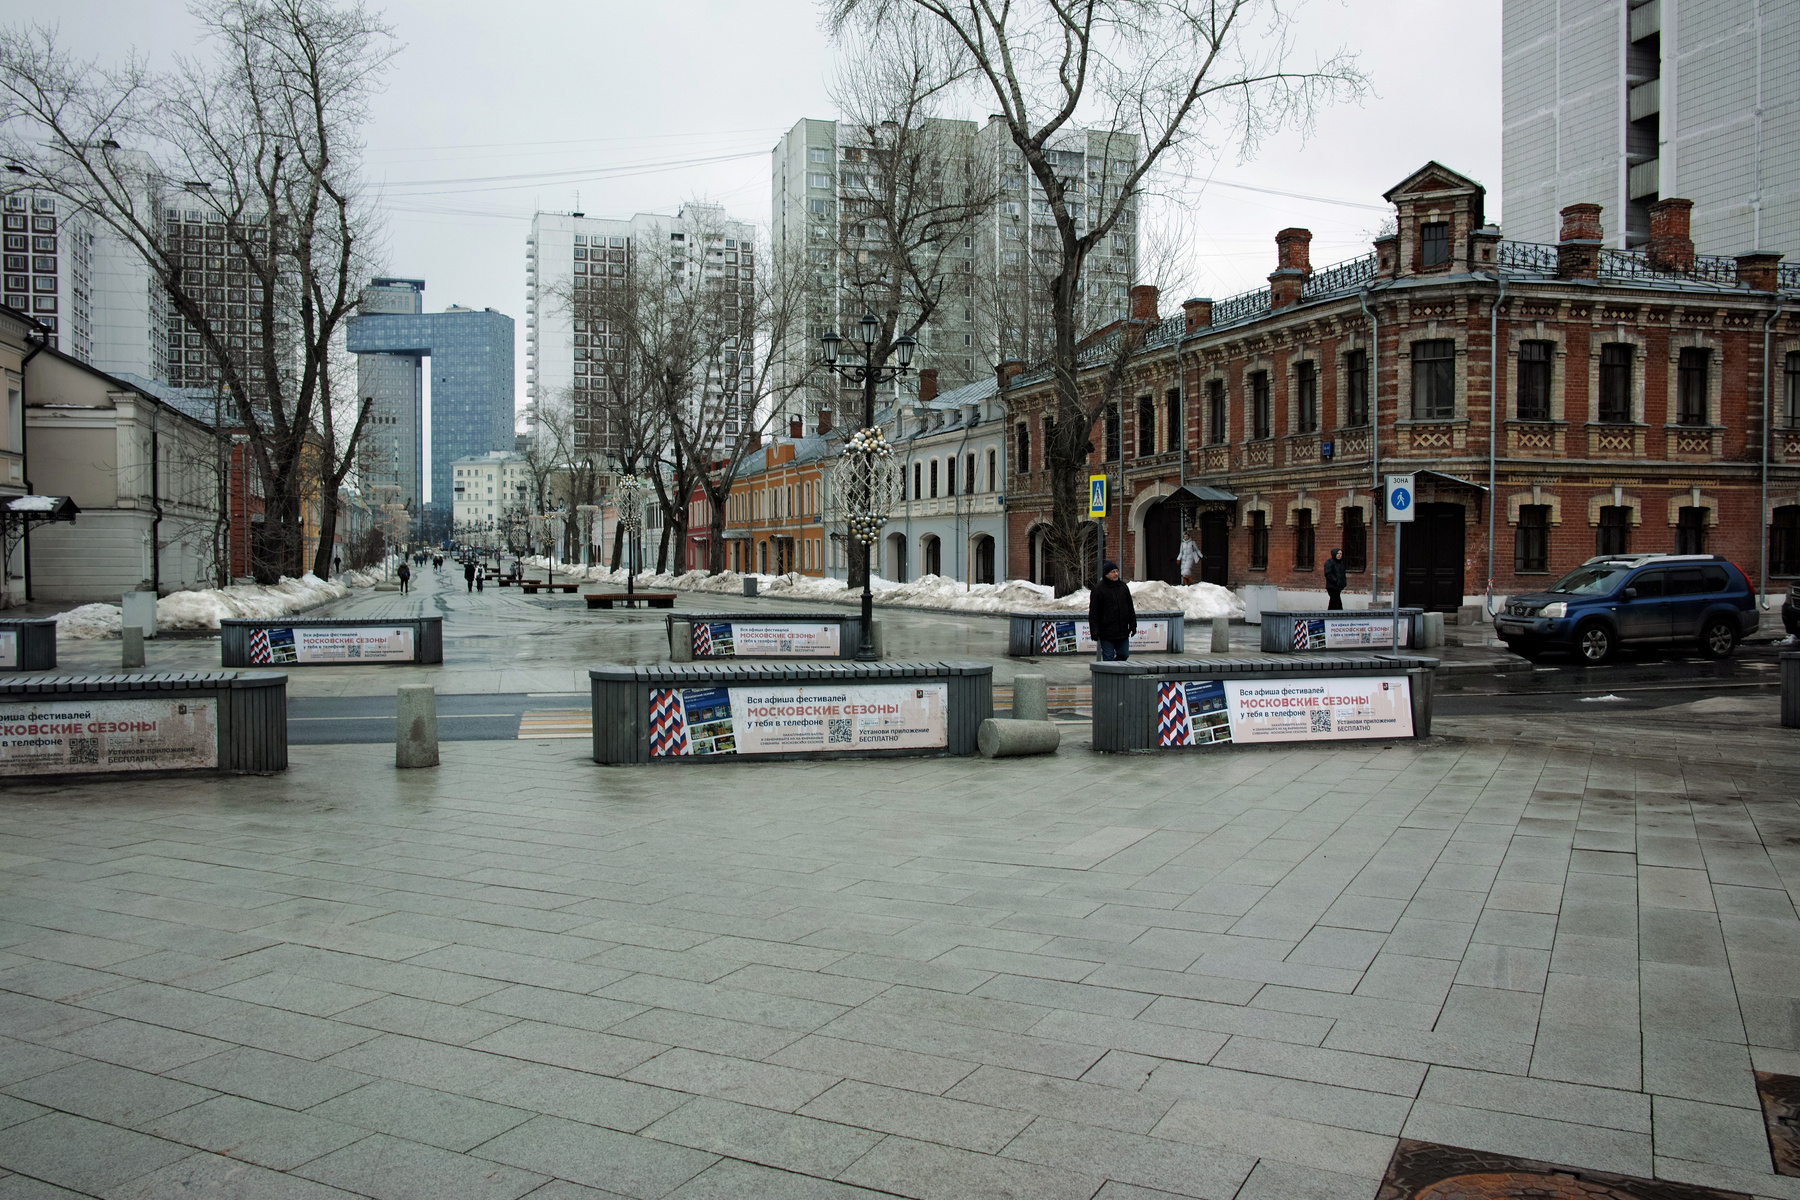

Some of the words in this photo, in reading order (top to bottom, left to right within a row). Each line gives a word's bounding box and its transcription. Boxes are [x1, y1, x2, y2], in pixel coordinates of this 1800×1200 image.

[1255, 688, 1280, 697] афиша
[1281, 687, 1324, 696] фестивалей
[764, 696, 794, 705] афиша
[796, 694, 846, 704] фестивалей
[1240, 697, 1319, 708] МОСКОВСКИЕ
[1322, 696, 1369, 706] СЕЗОНЫ
[747, 706, 840, 717] МОСКОВСКИЕ
[843, 704, 898, 715] СЕЗОНЫ
[1271, 710, 1306, 718] телефоне
[28, 711, 91, 722] фестивалей
[87, 721, 157, 734] СЕЗОНЫ
[783, 718, 823, 727] телефоне
[11, 738, 63, 747] телефоне
